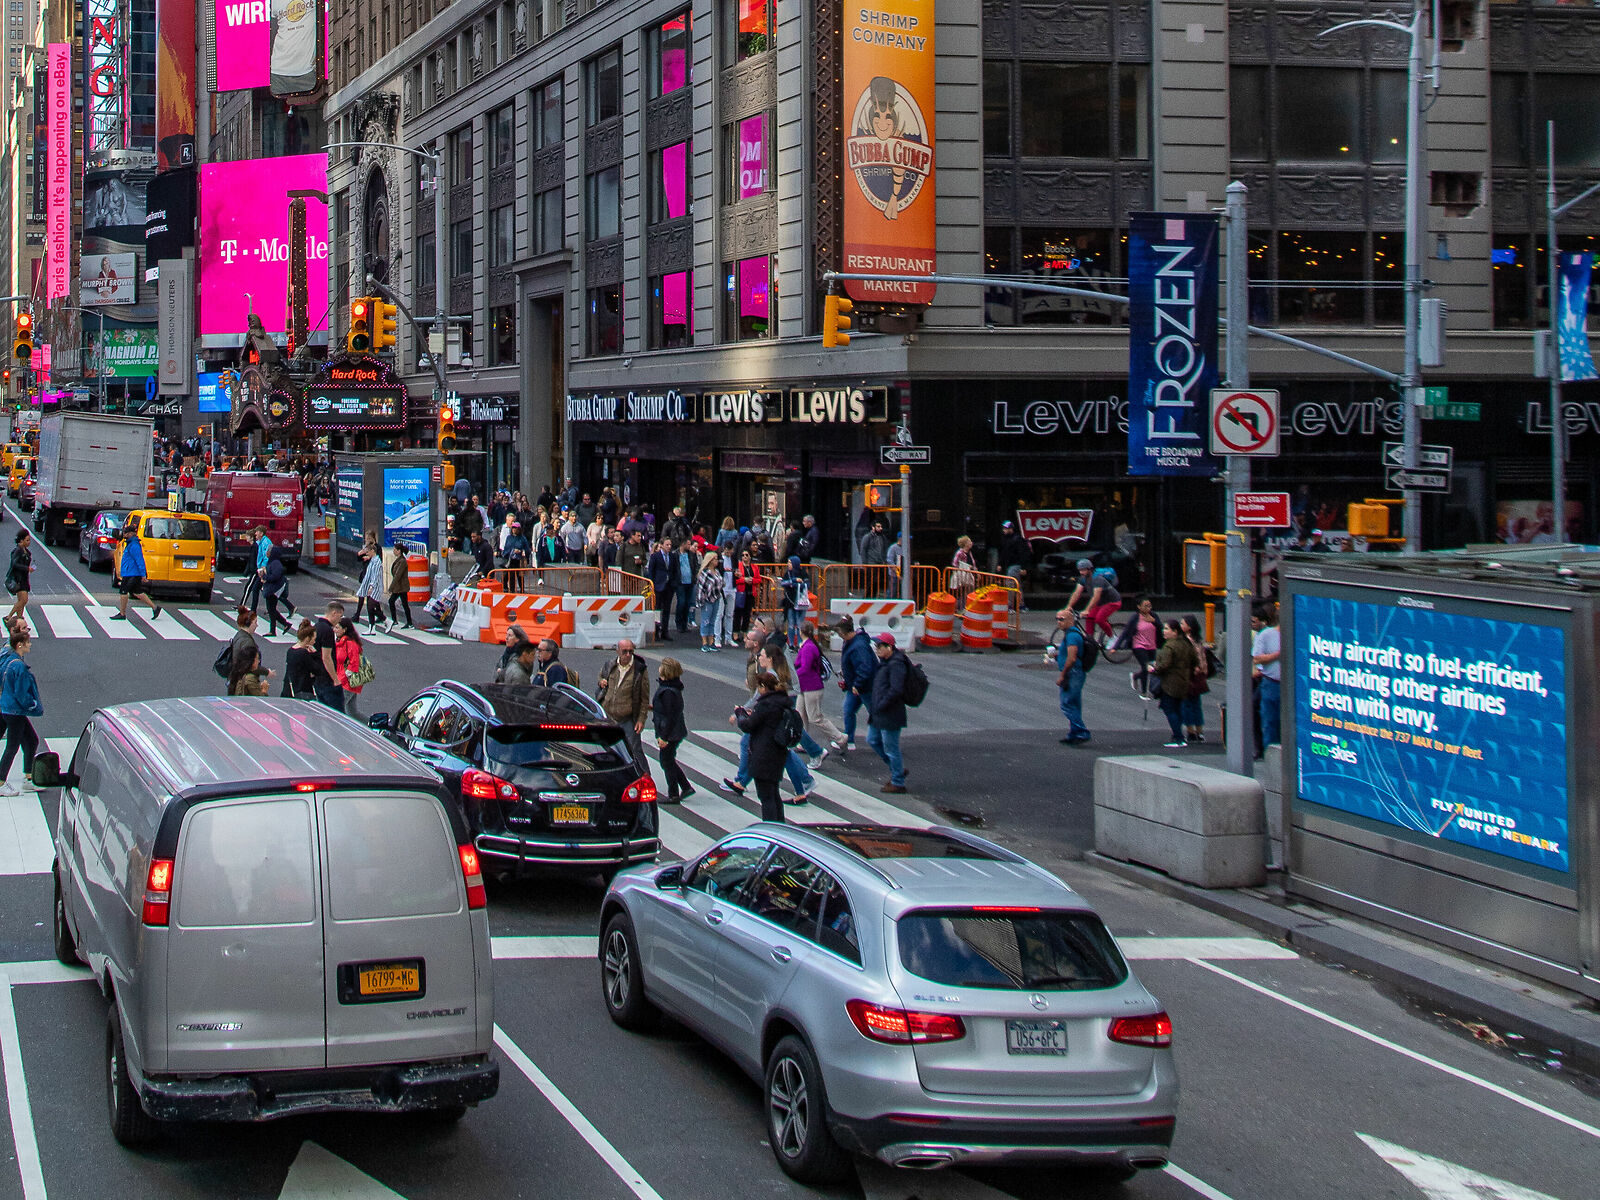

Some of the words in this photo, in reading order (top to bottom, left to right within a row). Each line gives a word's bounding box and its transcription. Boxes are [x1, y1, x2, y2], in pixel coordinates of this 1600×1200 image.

[860, 9, 919, 31] SHRIMP
[852, 28, 927, 51] COMPANY
[54, 51, 69, 85] eBay.
[56, 91, 65, 109] on
[54, 111, 67, 183] happening
[850, 140, 891, 165] BUBBA
[893, 141, 930, 171] GUMP
[863, 167, 892, 178] SHRIMP
[53, 186, 65, 207] It's
[53, 210, 65, 264] fashion.
[220, 237, 328, 264] T-Moile
[848, 254, 933, 273] RESTAURANT
[53, 268, 65, 299] Paris
[82, 279, 108, 288] MURPHY
[168, 279, 176, 313] REUTERS
[863, 279, 920, 293] MARKET
[168, 317, 176, 355] THOMSON
[1147, 245, 1206, 441] FROZEN
[104, 345, 147, 360] MAGNUM
[331, 369, 355, 380] Hard
[355, 369, 378, 381] Rock
[567, 395, 592, 420] BUBBA
[593, 394, 616, 420] GUMP
[627, 391, 664, 420] SHRIMP
[1450, 405, 1464, 417] 44
[888, 451, 904, 459] ONE
[908, 451, 925, 459] WAY
[1145, 447, 1160, 457] THE
[1161, 447, 1204, 459] BROADWAY
[1156, 456, 1191, 467] MUSICAL
[1248, 495, 1280, 504] STANDING
[1309, 634, 1343, 659] New
[1345, 640, 1402, 669] aircraft
[1404, 653, 1425, 673] so
[1427, 652, 1548, 698] fuel-efficient,
[1309, 659, 1331, 682] it's
[1334, 663, 1390, 698] making
[1393, 676, 1437, 703] other
[1440, 684, 1506, 716] airlines
[1310, 687, 1353, 714] green
[1355, 694, 1389, 721] with
[1392, 705, 1439, 734] envy.
[1311, 712, 1334, 727] Proud
[1333, 718, 1343, 728] to
[1343, 720, 1379, 738] introduce
[1379, 727, 1394, 741] the
[1394, 730, 1411, 744] 737
[1411, 734, 1433, 750] MAX
[1434, 740, 1444, 752] to
[1444, 743, 1461, 755] our
[1461, 745, 1484, 761] fleet.
[1430, 797, 1455, 813] FLY
[1463, 805, 1517, 829] UNITED
[1457, 816, 1483, 833] OUT
[1483, 823, 1501, 837] OF
[1501, 827, 1560, 854] NEWARK
[406, 1006, 468, 1021] CHEVROLET
